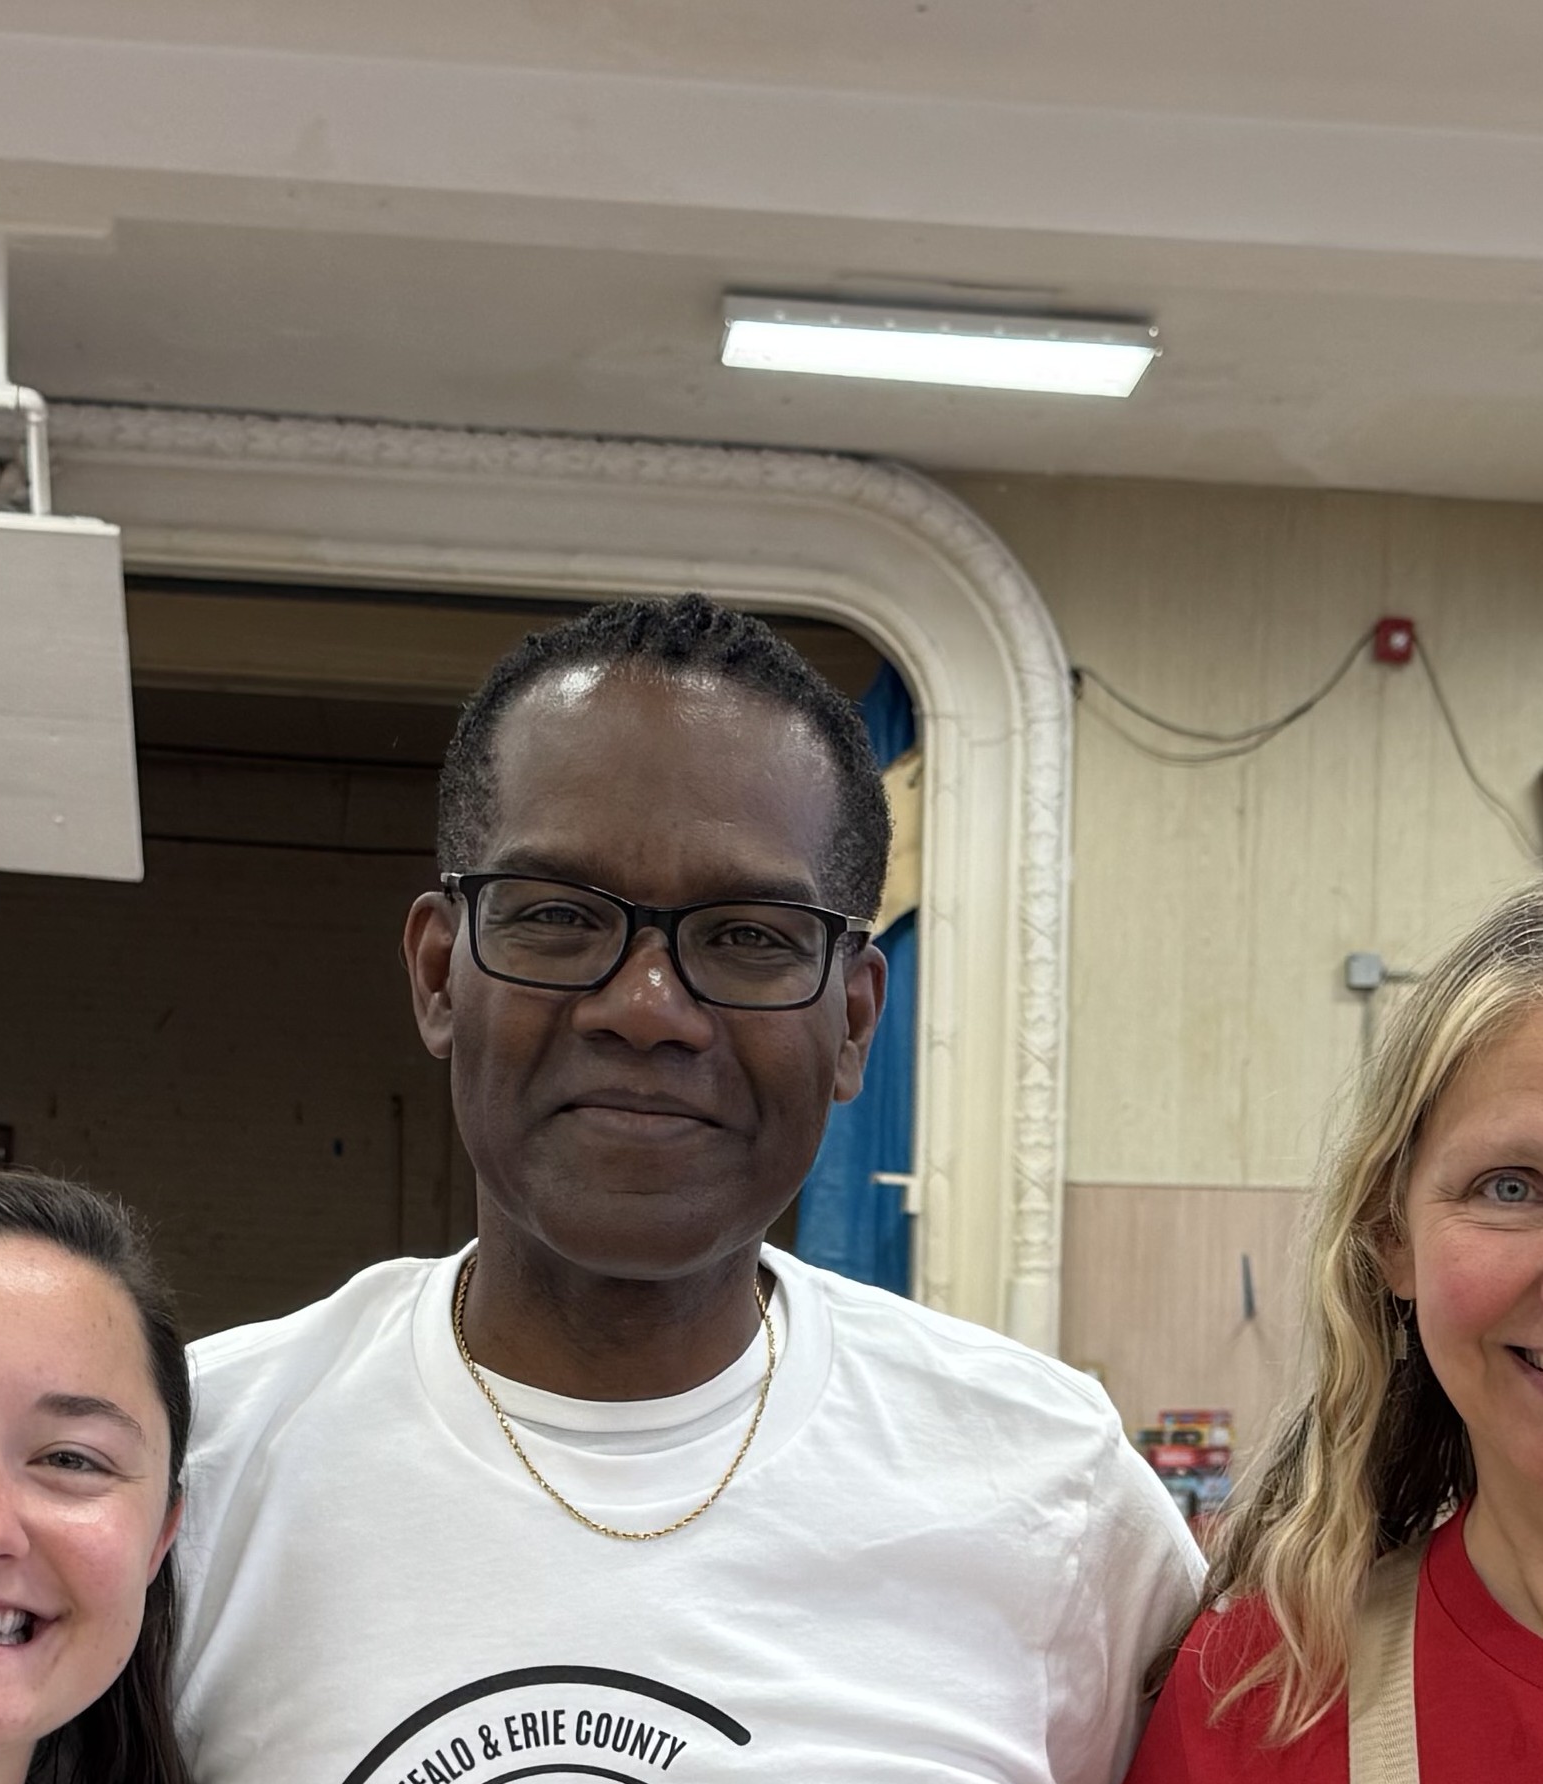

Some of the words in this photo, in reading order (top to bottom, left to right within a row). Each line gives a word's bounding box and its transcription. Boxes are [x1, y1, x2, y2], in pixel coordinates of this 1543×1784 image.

[478, 1724, 503, 1759] &
[505, 1709, 566, 1755] ERIE
[575, 1709, 686, 1771] COUNTY
